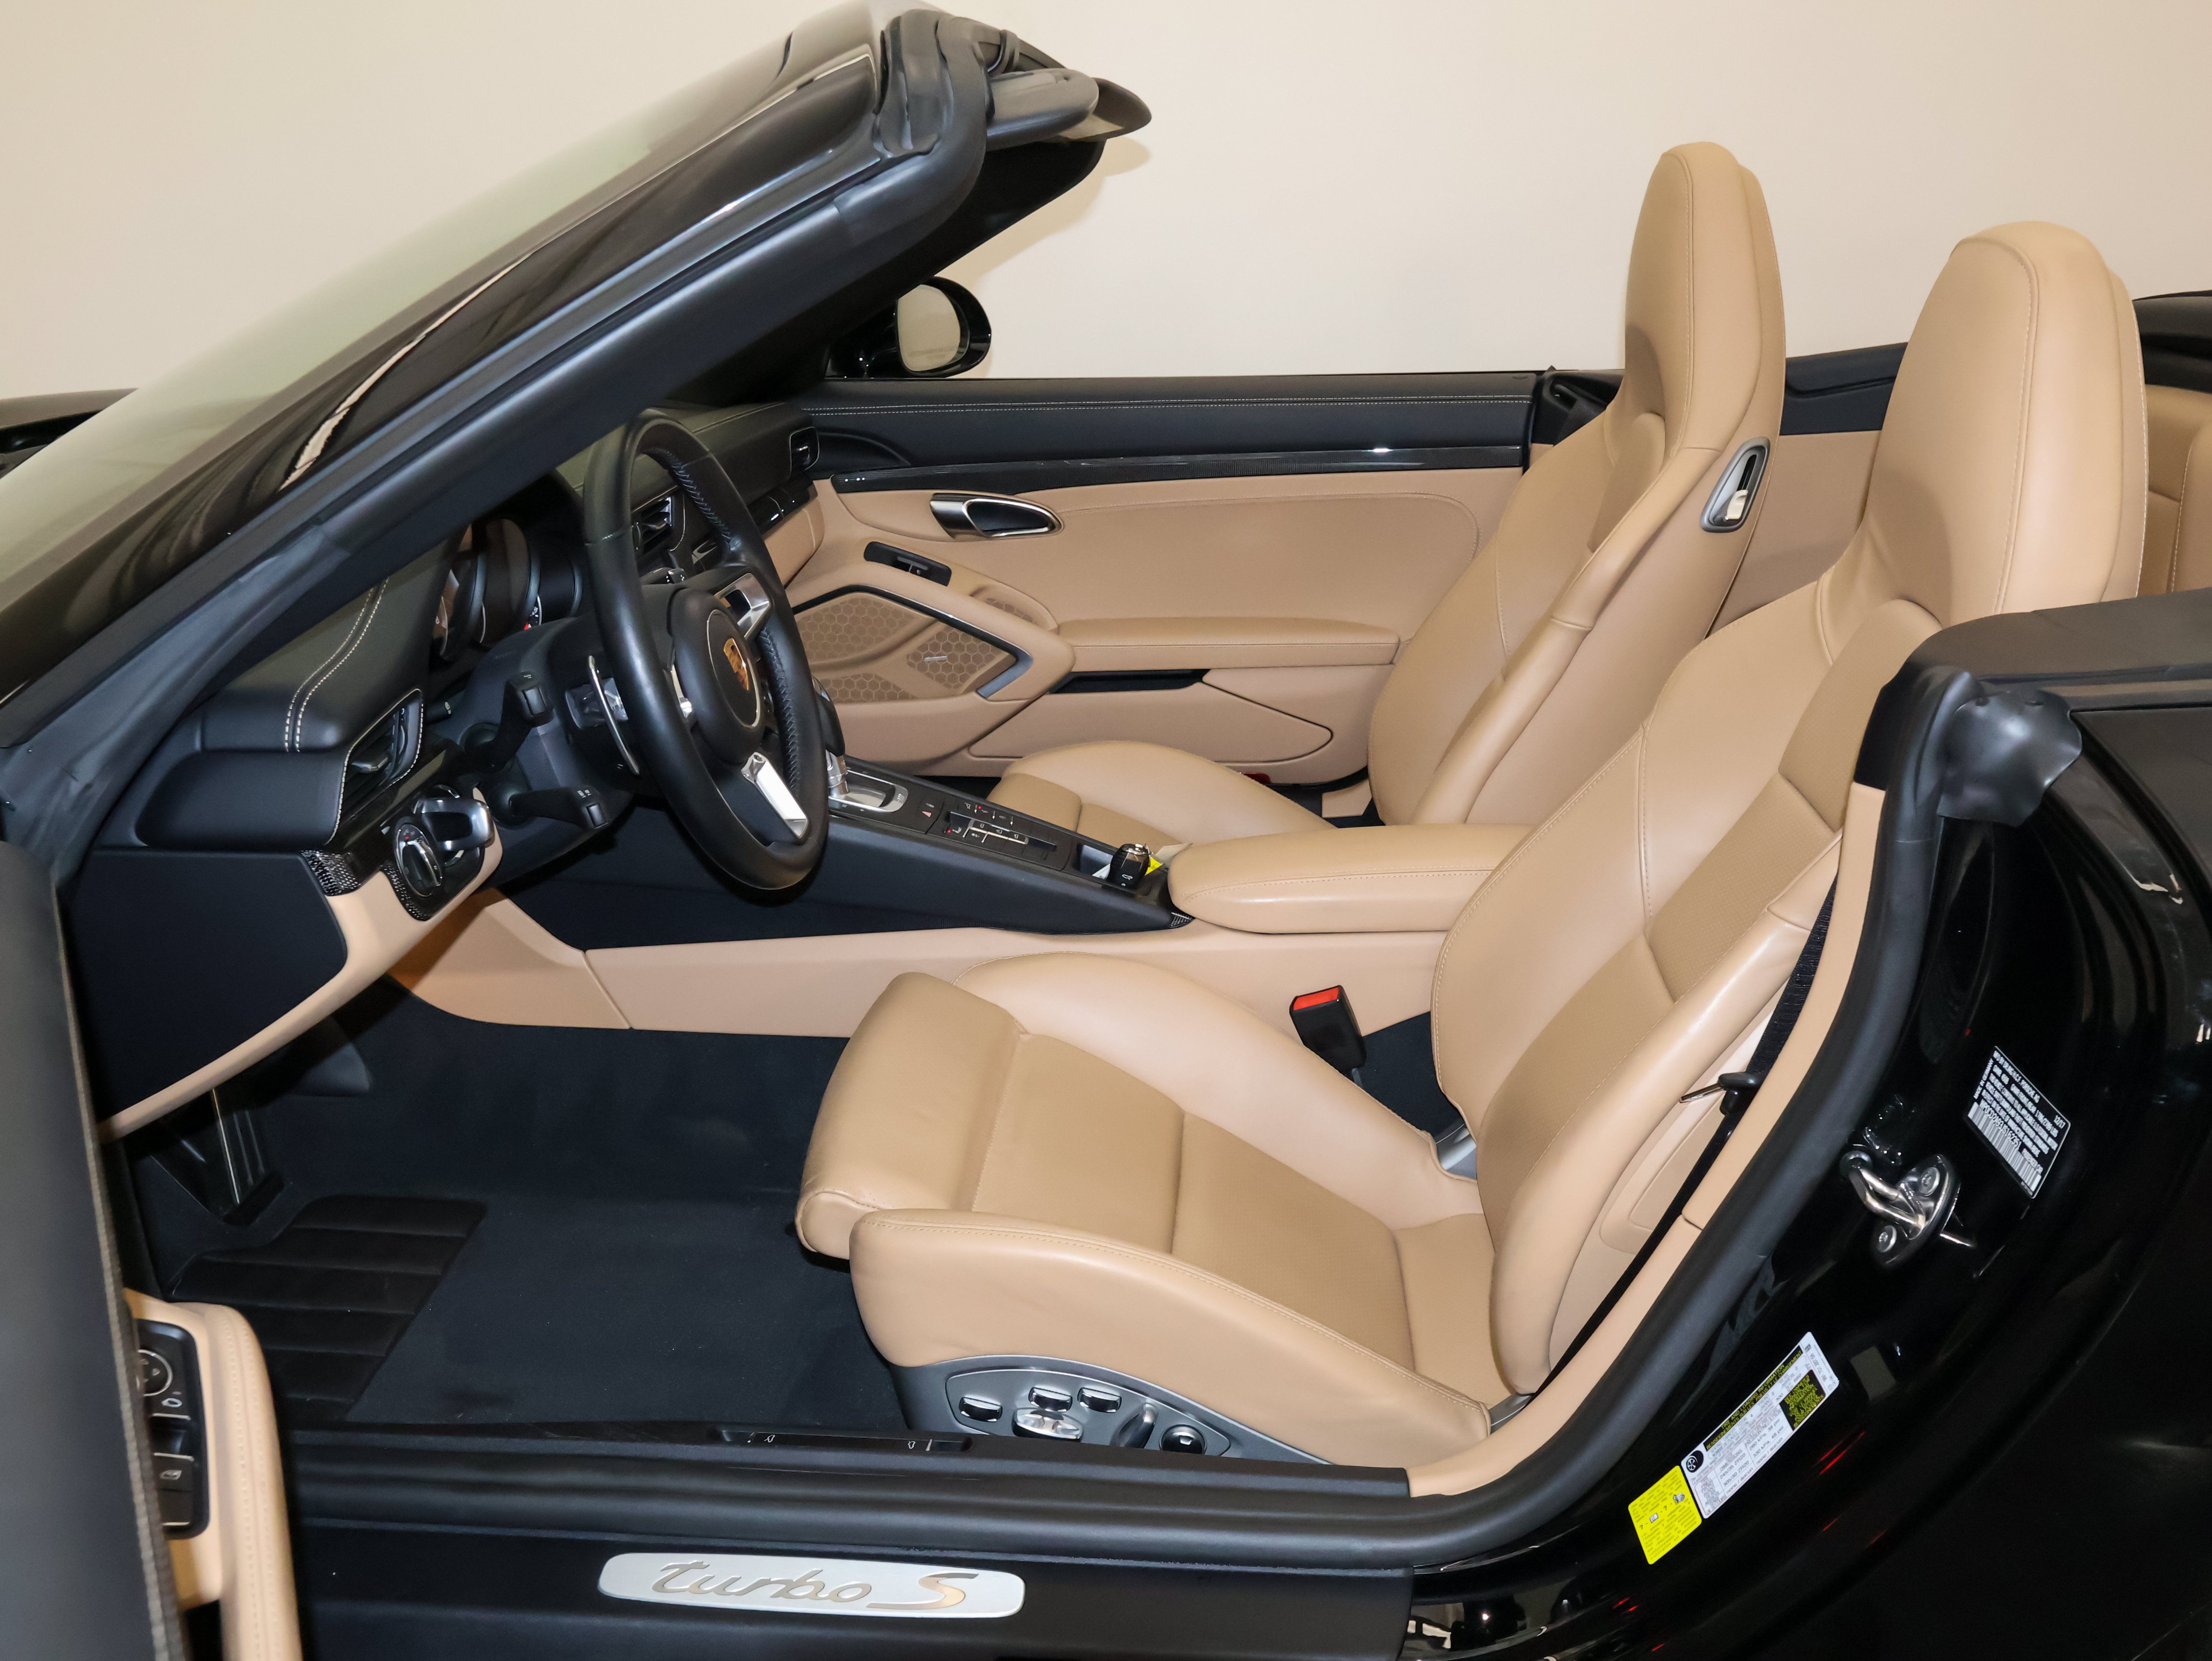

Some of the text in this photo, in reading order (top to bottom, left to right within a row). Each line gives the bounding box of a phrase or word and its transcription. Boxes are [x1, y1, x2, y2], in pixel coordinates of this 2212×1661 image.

[1974, 1085, 1982, 1099] MADE
[1982, 1058, 1994, 1080] GERMANY
[1721, 1419, 1730, 1430] TIRE
[1730, 1409, 1740, 1421] AND
[1739, 1391, 1758, 1412] LOADING
[1757, 1363, 1785, 1394] INFORMATION
[1775, 1392, 1784, 1403] 300
[1756, 1453, 1767, 1466] none
[1719, 1463, 1734, 1480] 245/35
[1726, 1482, 1737, 1496] none
[651, 1560, 979, 1610] turbo S
